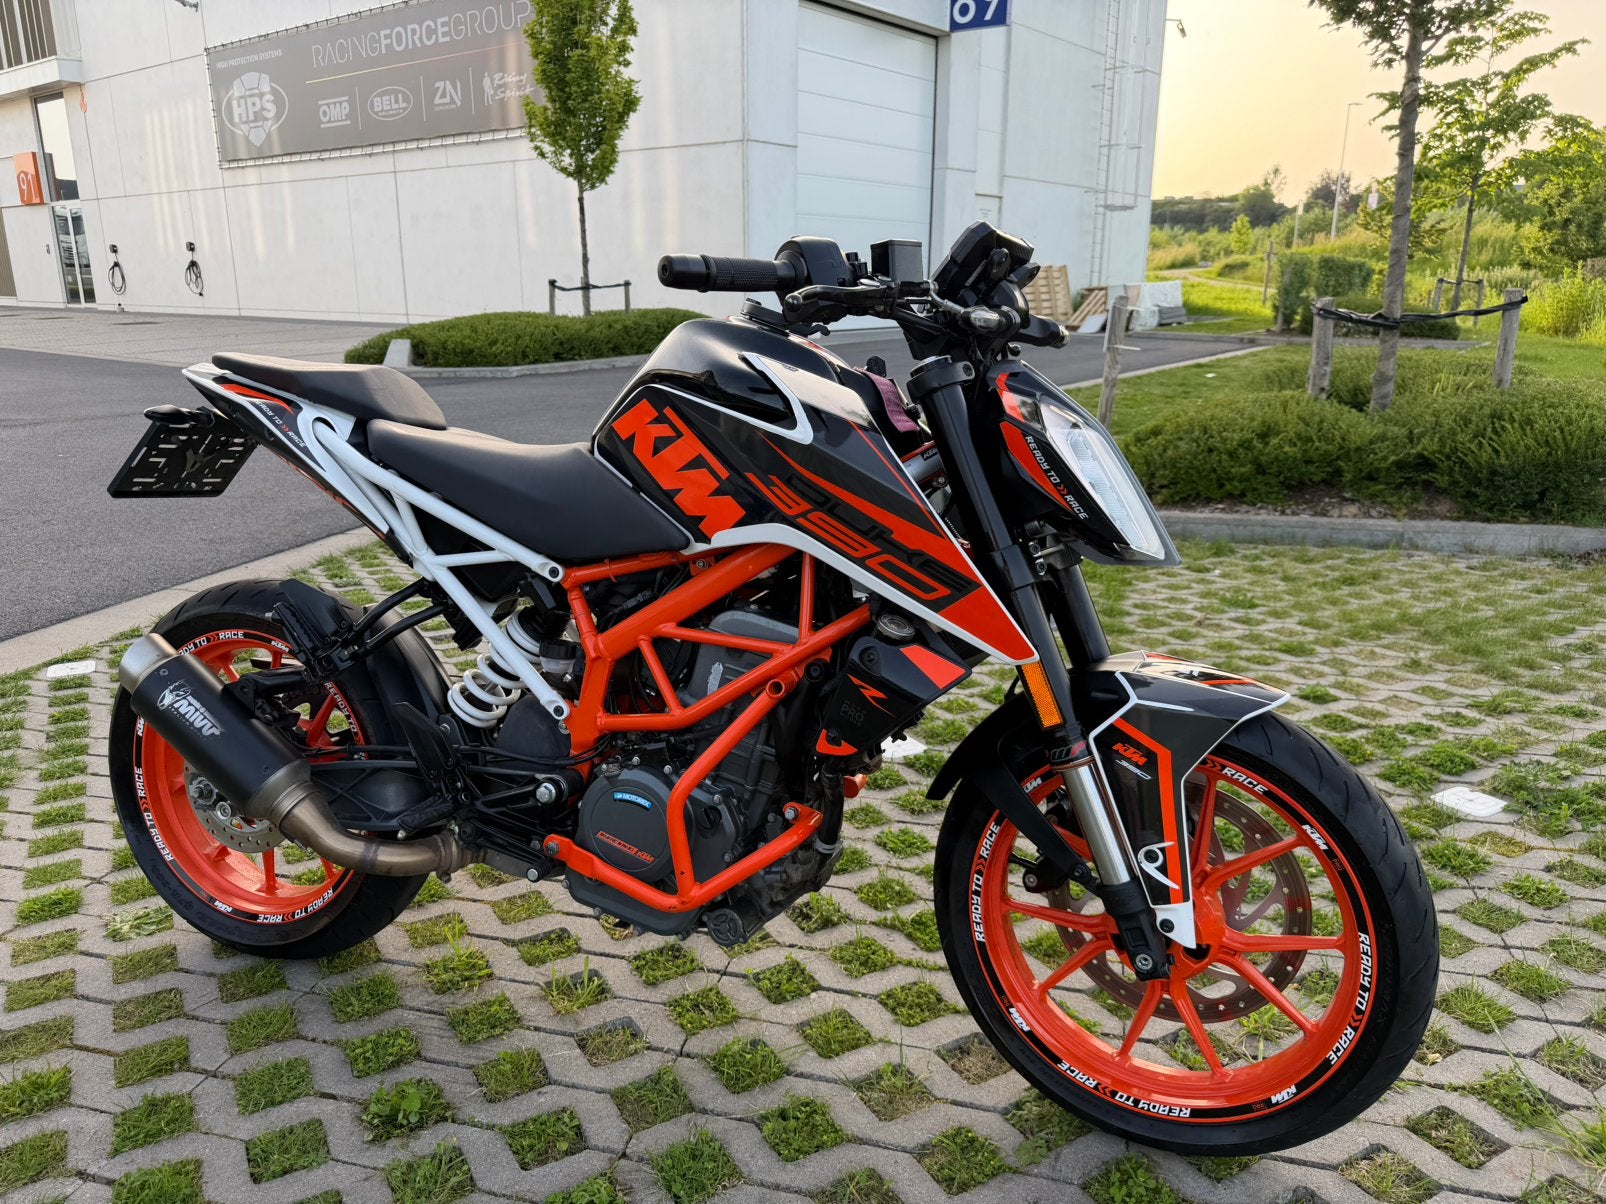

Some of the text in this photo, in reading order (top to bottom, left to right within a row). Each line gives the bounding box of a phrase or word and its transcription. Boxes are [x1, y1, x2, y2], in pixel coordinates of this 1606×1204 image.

[232, 96, 277, 122] HPS
[319, 101, 350, 122] OMP
[373, 94, 408, 111] BELL
[20, 172, 35, 203] 91
[611, 398, 747, 541] KTM
[1025, 435, 1089, 521] READY TO RACE
[195, 637, 207, 647] TO
[218, 631, 245, 640] RACE
[324, 682, 358, 732] READY TO
[1112, 742, 1148, 766] KTM
[1221, 767, 1269, 795] RACE
[135, 767, 174, 861] READY TO RACE
[1301, 824, 1329, 850] KTM
[971, 821, 1000, 942] READY TO RACE
[256, 887, 334, 923] READY TO RACE
[1325, 932, 1372, 1065] READY TO RACE
[1008, 1007, 1031, 1032] KTM
[1057, 1060, 1191, 1118] READY TO RACE
[1271, 1084, 1297, 1104] KTM
